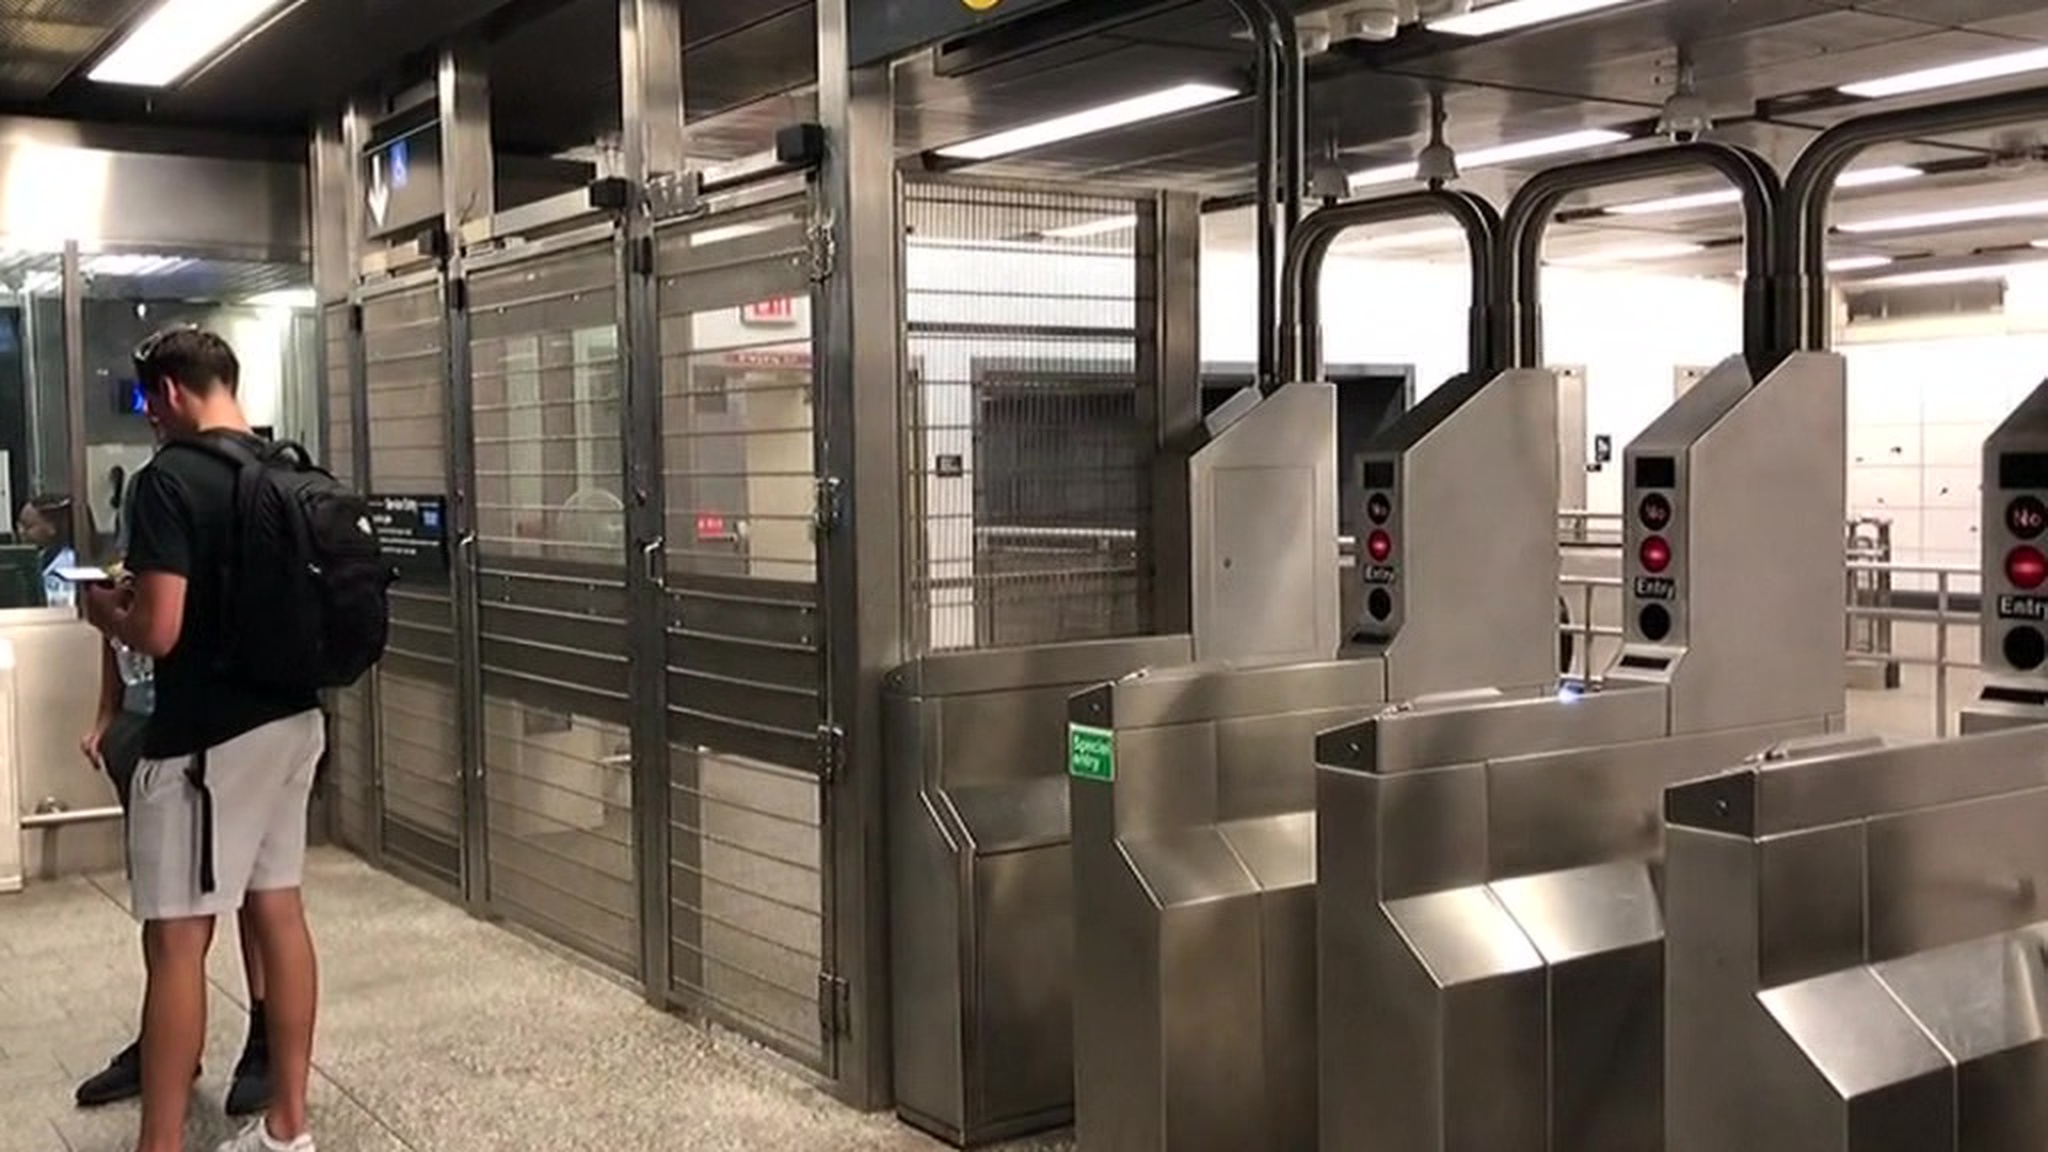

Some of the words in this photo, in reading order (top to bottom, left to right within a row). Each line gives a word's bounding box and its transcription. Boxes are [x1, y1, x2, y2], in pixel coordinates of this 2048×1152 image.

[1645, 503, 1665, 521] No
[2014, 510, 2042, 527] No
[1636, 579, 1673, 599] Entry
